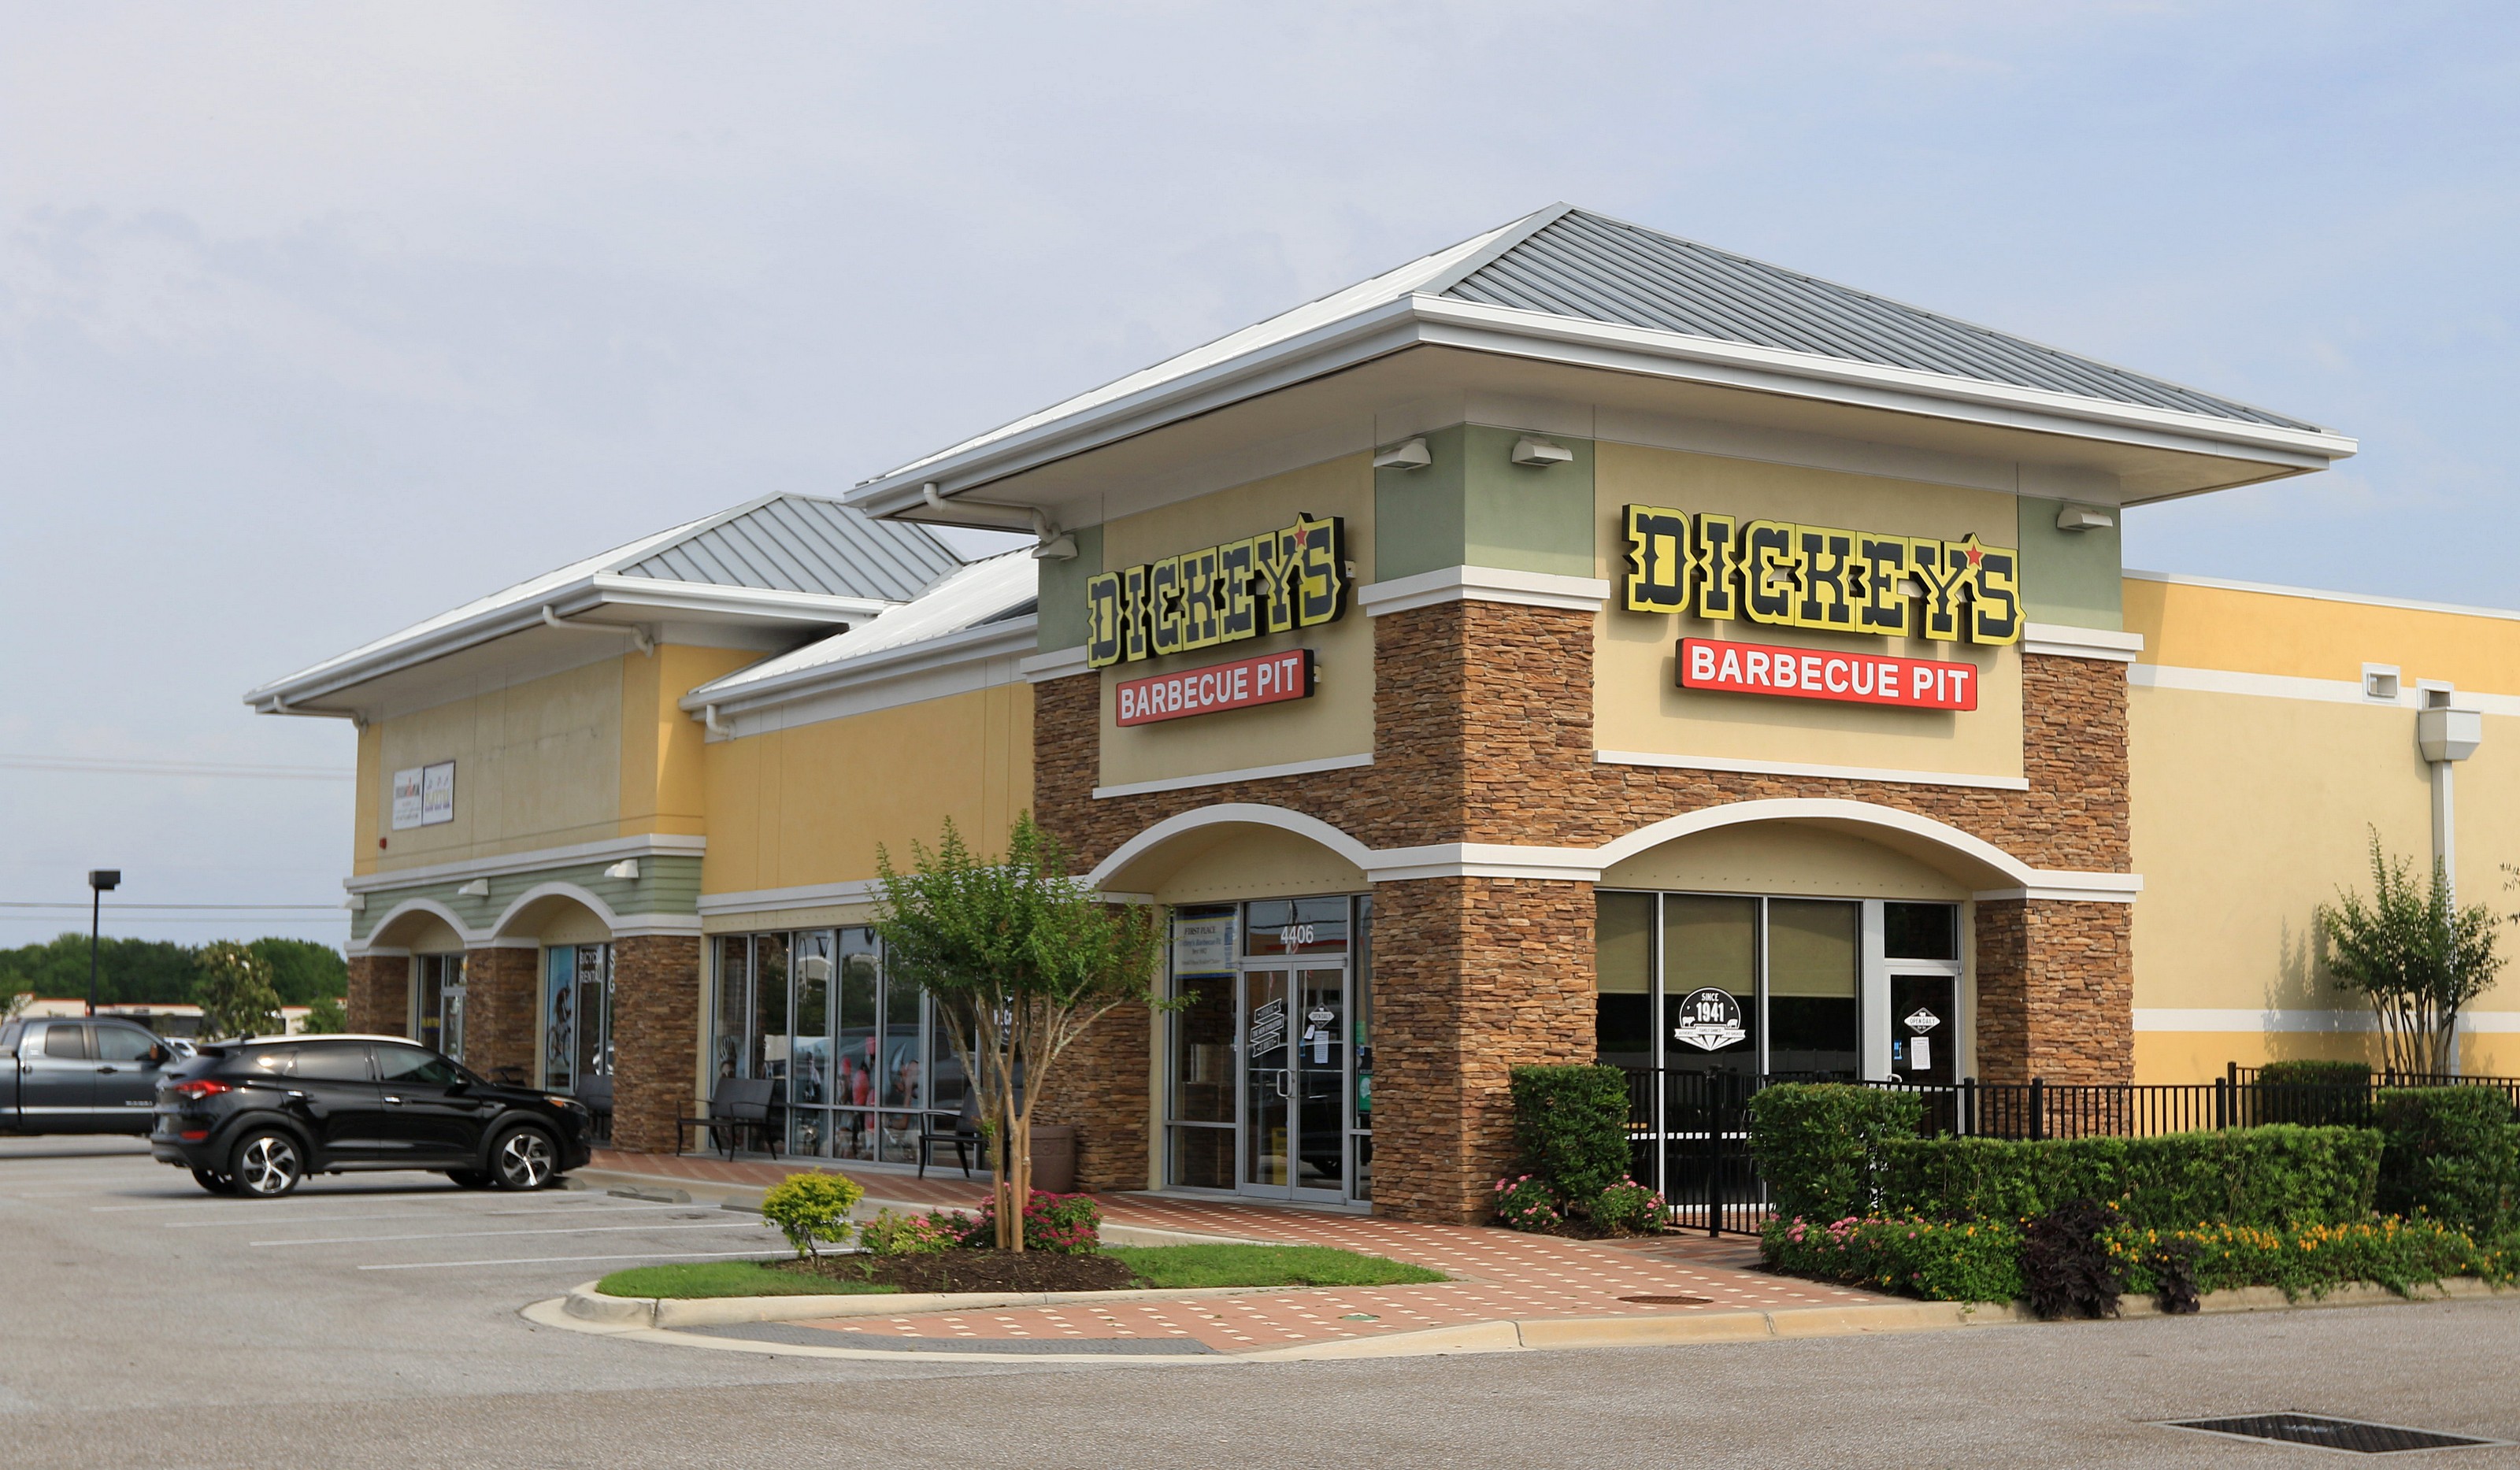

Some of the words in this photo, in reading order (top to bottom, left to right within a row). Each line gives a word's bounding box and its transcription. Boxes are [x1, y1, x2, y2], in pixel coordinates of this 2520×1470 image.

[1690, 644, 1900, 698] BARBECUE
[1912, 665, 1969, 704] PIT
[1121, 666, 1249, 720] BARBECUE
[1257, 657, 1299, 697] PIT
[1184, 927, 1200, 935] FIRST
[1200, 925, 1217, 935] PLACE
[1280, 924, 1314, 944] 4406
[579, 969, 602, 983] RENTAL
[1701, 992, 1719, 1002] SINCE
[1695, 1002, 1725, 1022] 1941
